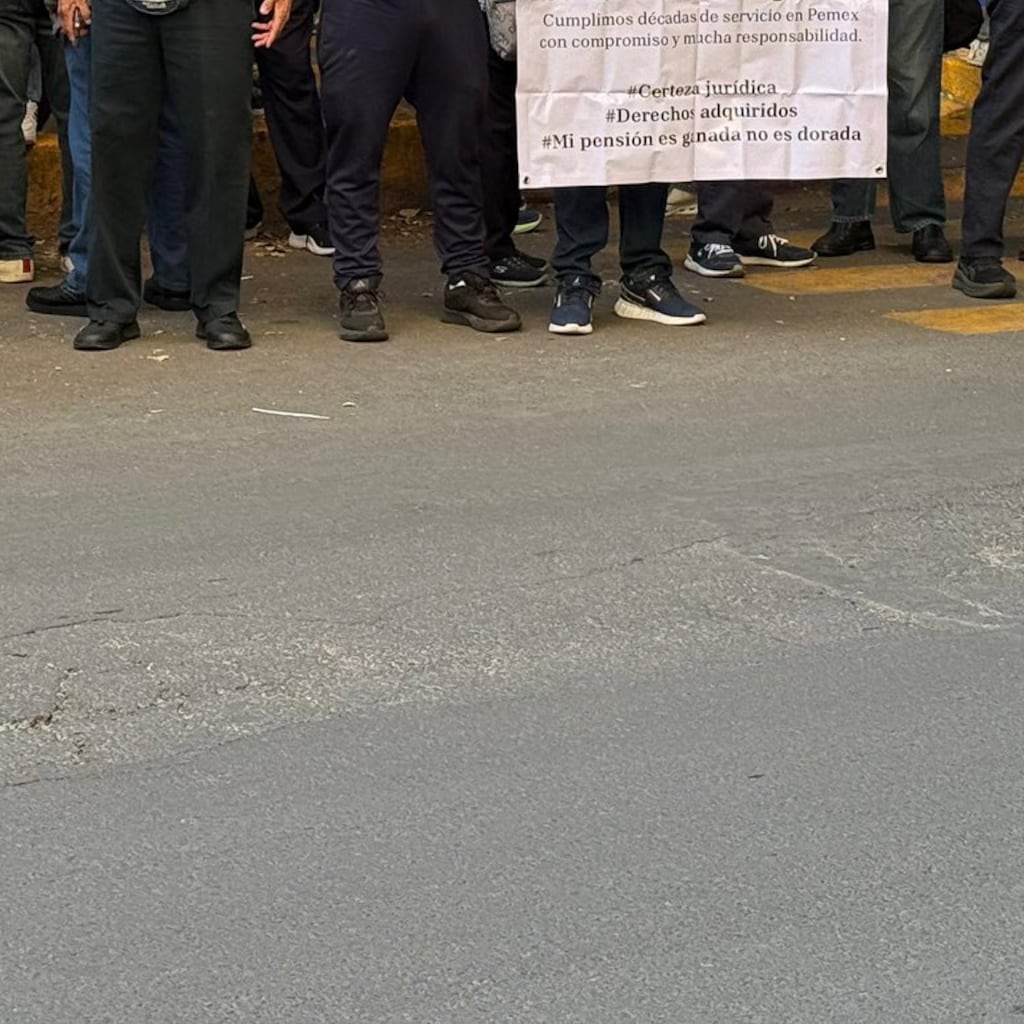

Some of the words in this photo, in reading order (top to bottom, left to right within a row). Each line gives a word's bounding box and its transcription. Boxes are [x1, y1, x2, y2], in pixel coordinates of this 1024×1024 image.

[543, 13, 634, 30] Cumplimos
[637, 9, 697, 25] décadas
[699, 8, 719, 23] de
[722, 8, 783, 23] servicio
[786, 10, 804, 22] en
[808, 7, 860, 22] Pemex
[539, 36, 568, 50] con
[571, 33, 669, 51] compromiso
[671, 35, 681, 49] y
[735, 28, 862, 46] responsabilidad.
[628, 84, 700, 99] #Certeza
[705, 80, 777, 98] jurídica
[606, 106, 696, 123] #Derechos
[700, 103, 798, 121] adquiridos
[541, 133, 574, 149] #Mi
[580, 130, 654, 151] pensión
[658, 133, 677, 145] es
[747, 129, 769, 142] no
[773, 129, 792, 142] es
[798, 126, 862, 142] dorada
